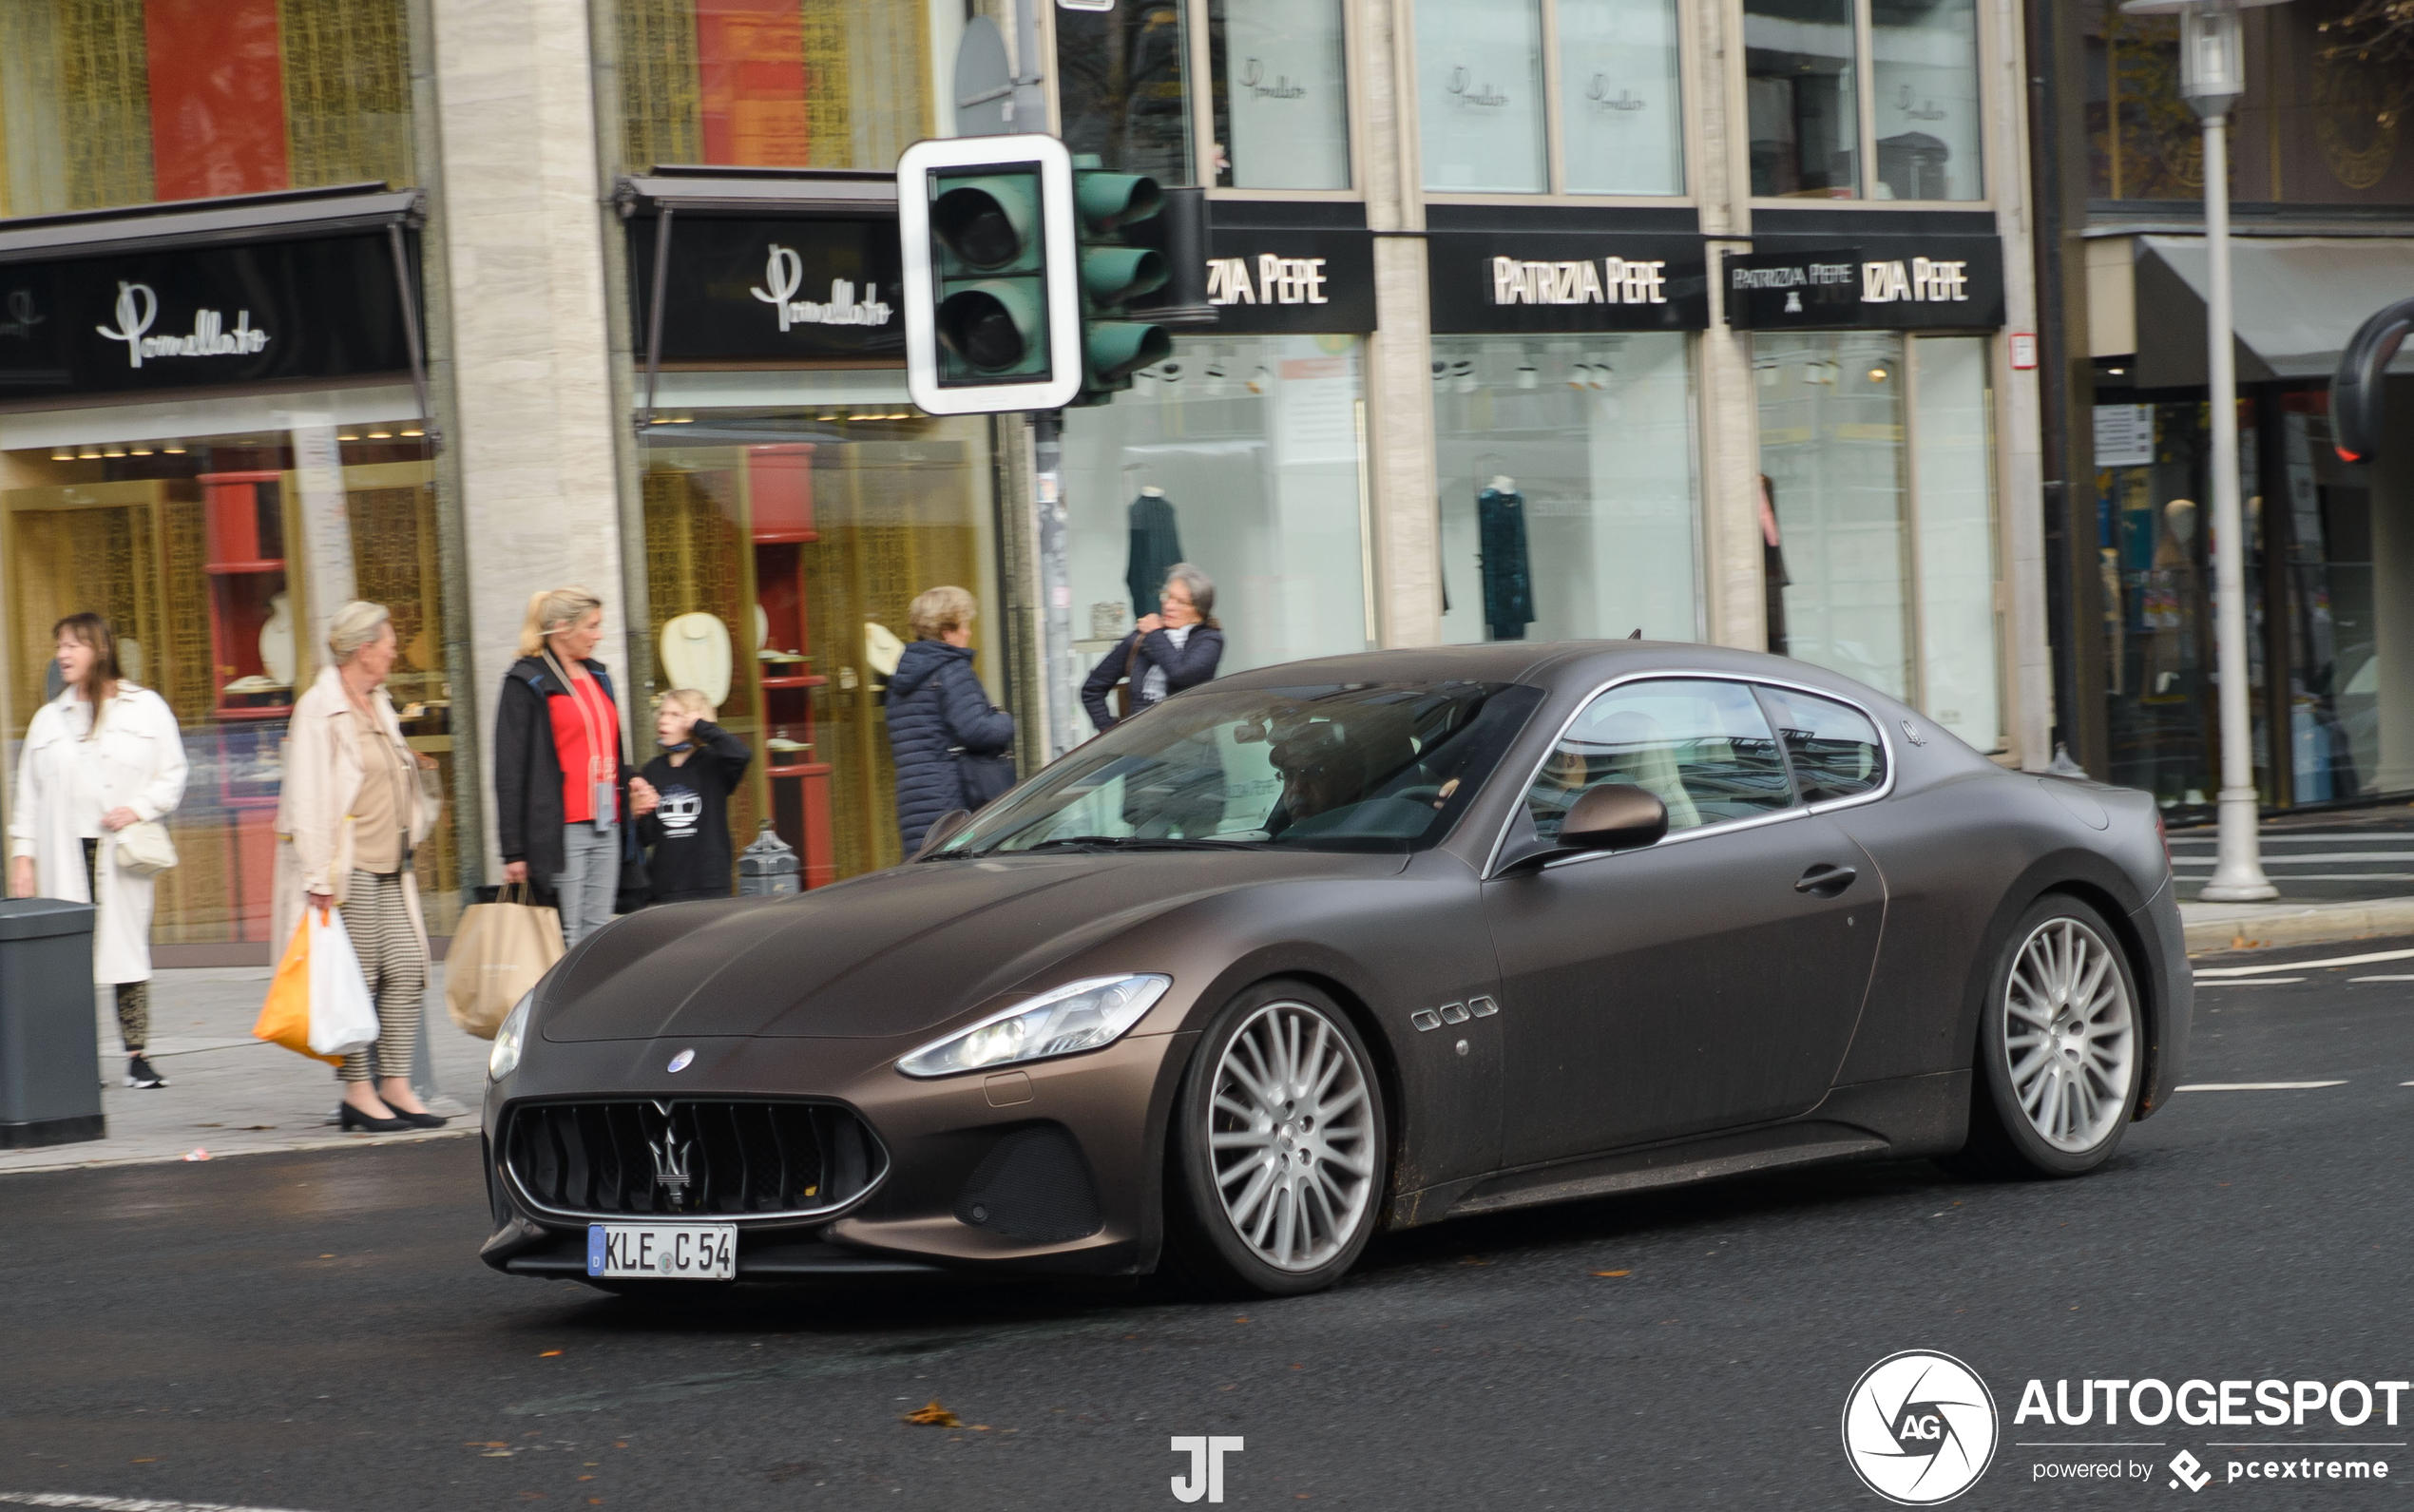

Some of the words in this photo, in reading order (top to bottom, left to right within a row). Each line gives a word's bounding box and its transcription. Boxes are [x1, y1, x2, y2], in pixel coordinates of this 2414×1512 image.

[1206, 258, 1256, 305] ZIA
[1258, 253, 1329, 304] PEPE
[1493, 256, 1605, 305] PATRIZIA
[1605, 256, 1668, 304] PEPE
[1809, 263, 1853, 285] PEPE
[1860, 259, 1912, 302] IZIA
[1912, 256, 1969, 302] PEPE
[96, 280, 271, 368] Pomellato
[592, 1255, 601, 1269] D
[605, 1232, 656, 1271] KLE
[676, 1233, 690, 1271] C
[699, 1233, 731, 1272] 54
